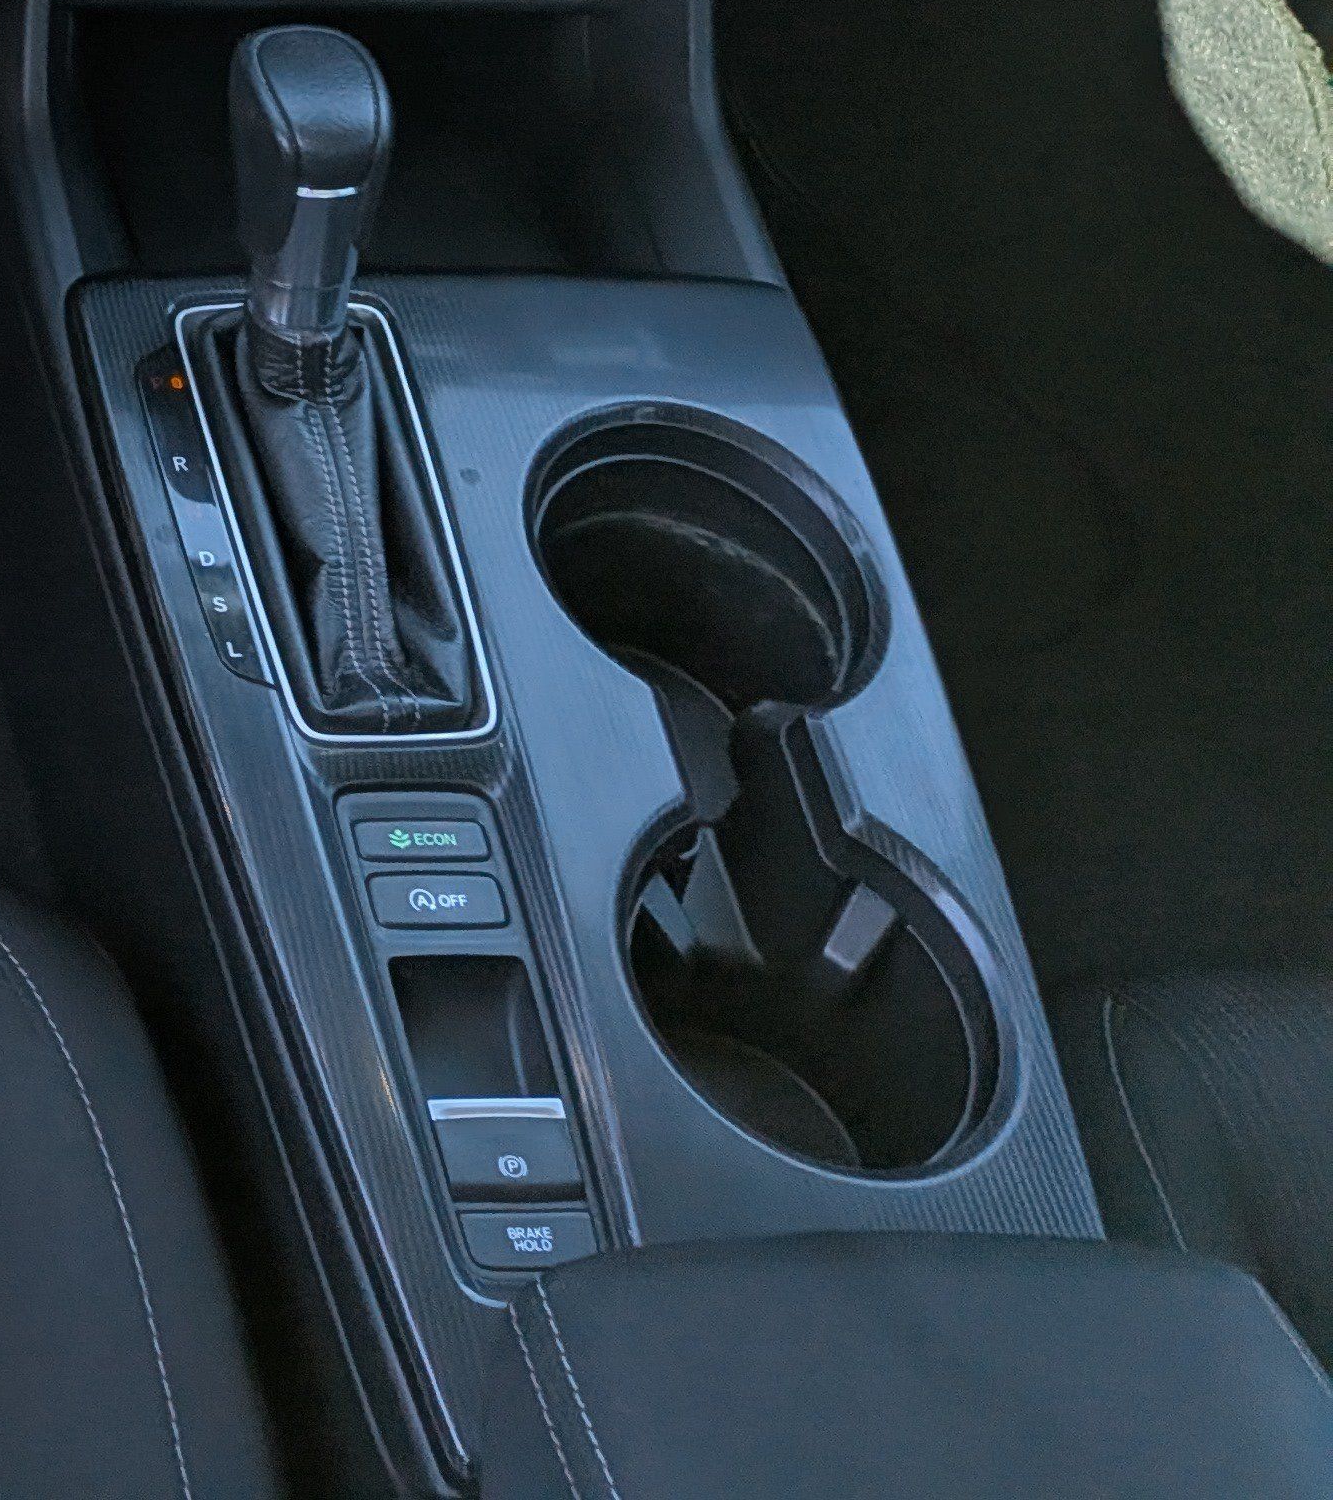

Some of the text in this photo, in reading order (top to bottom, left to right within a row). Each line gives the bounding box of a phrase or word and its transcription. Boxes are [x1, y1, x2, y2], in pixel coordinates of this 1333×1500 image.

[172, 456, 189, 472] R
[198, 551, 215, 567] D
[213, 596, 229, 613] S
[226, 641, 243, 658] L
[413, 832, 457, 846] ECON
[438, 894, 468, 908] OFF
[506, 1225, 554, 1240] BRAKE
[513, 1239, 553, 1252] HOLD
